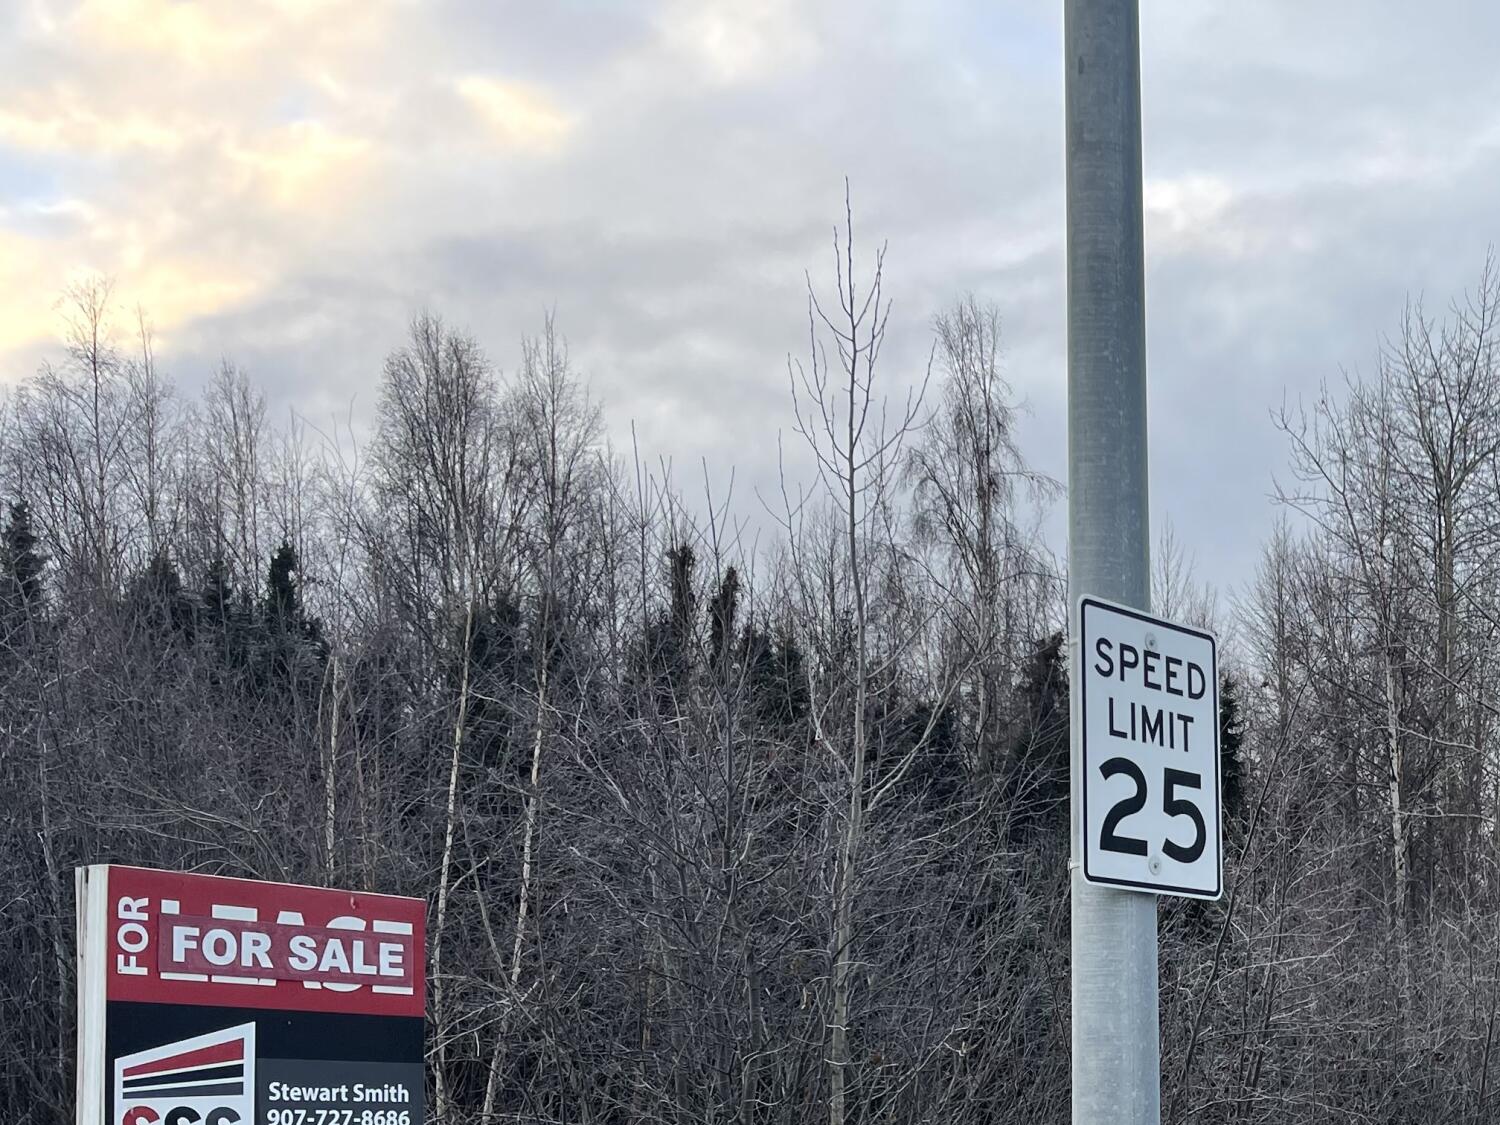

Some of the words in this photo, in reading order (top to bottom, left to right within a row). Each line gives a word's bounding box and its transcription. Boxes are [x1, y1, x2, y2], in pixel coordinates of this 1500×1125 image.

[1094, 637, 1206, 700] SPEED
[1109, 697, 1194, 752] LIMIT
[1099, 757, 1206, 863] 25
[117, 895, 149, 976] FOR
[172, 925, 274, 969] FOR
[288, 935, 405, 977] SALE
[268, 1081, 348, 1102] Stewart
[353, 1083, 409, 1102] Smith
